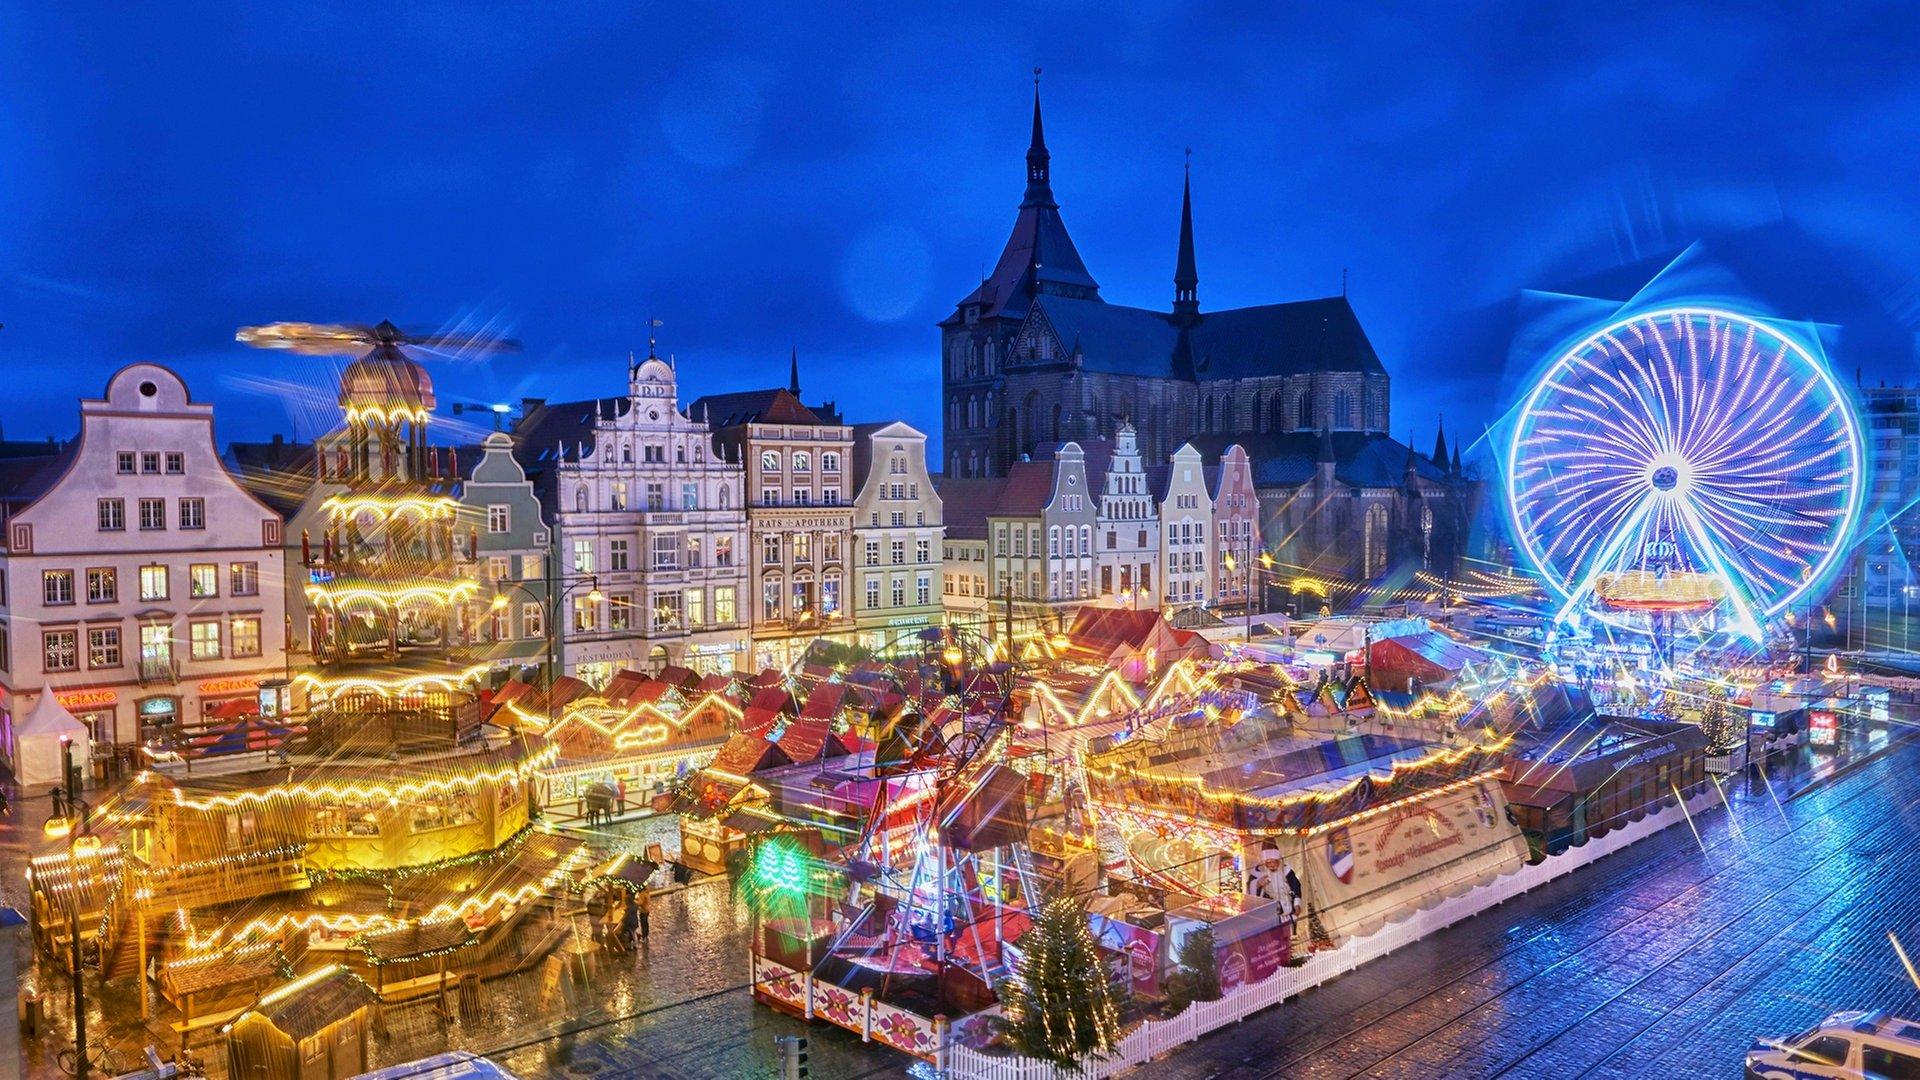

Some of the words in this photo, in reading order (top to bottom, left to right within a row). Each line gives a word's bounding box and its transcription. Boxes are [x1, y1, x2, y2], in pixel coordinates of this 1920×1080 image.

[759, 519, 782, 528] RATS
[795, 518, 845, 527] APOTHEKE
[576, 650, 630, 662] FESTMODEN
